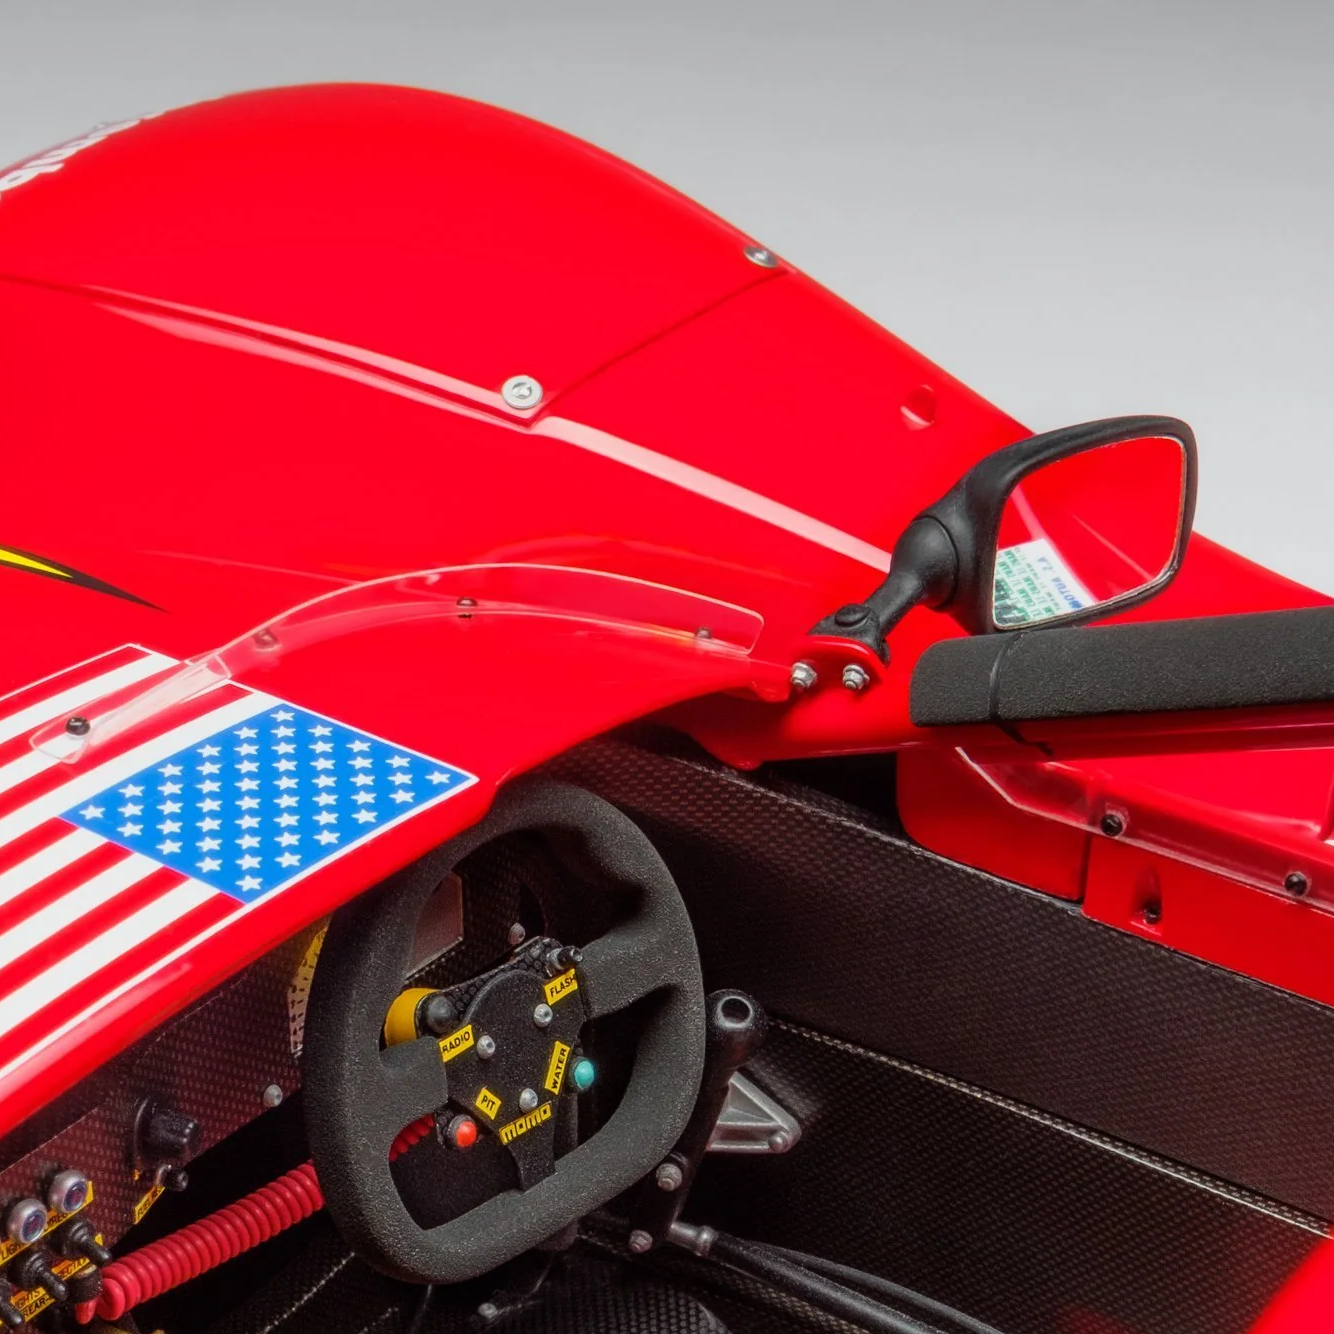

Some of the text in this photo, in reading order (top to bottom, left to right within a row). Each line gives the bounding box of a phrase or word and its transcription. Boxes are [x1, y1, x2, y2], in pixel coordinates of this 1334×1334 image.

[441, 1030, 471, 1055] RADIO
[551, 1047, 568, 1090] WATER
[481, 1094, 497, 1112] PIT
